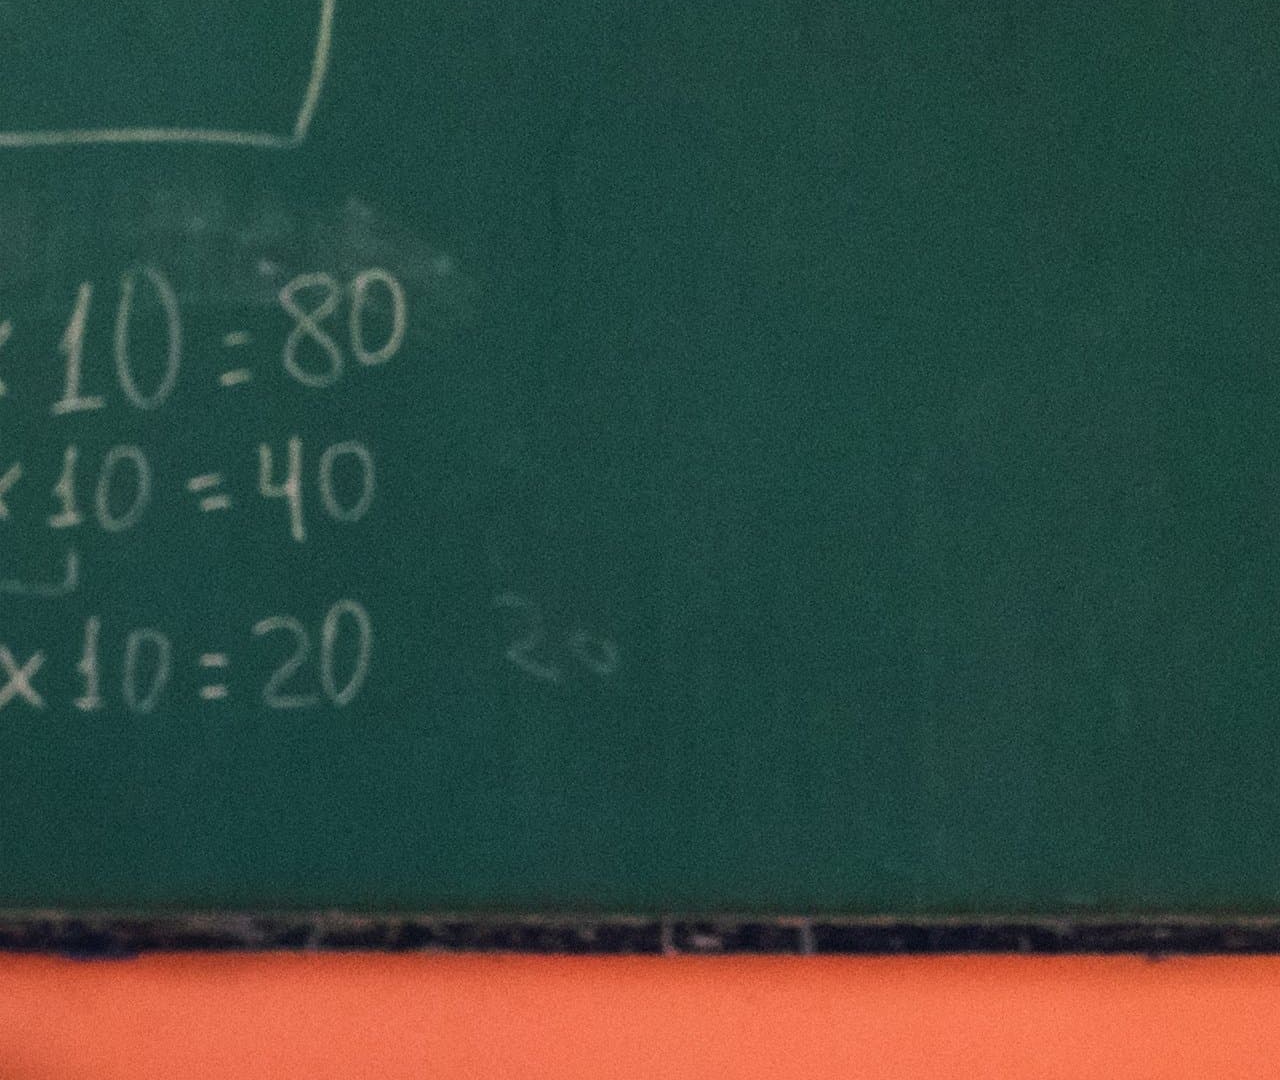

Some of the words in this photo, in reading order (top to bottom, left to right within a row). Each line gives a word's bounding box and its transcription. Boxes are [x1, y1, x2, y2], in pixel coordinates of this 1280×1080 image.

[51, 265, 182, 414] 10
[278, 267, 405, 387] 80
[49, 444, 150, 531] 10
[257, 435, 375, 543] 40
[74, 616, 172, 713] 10
[251, 598, 373, 708] 20
